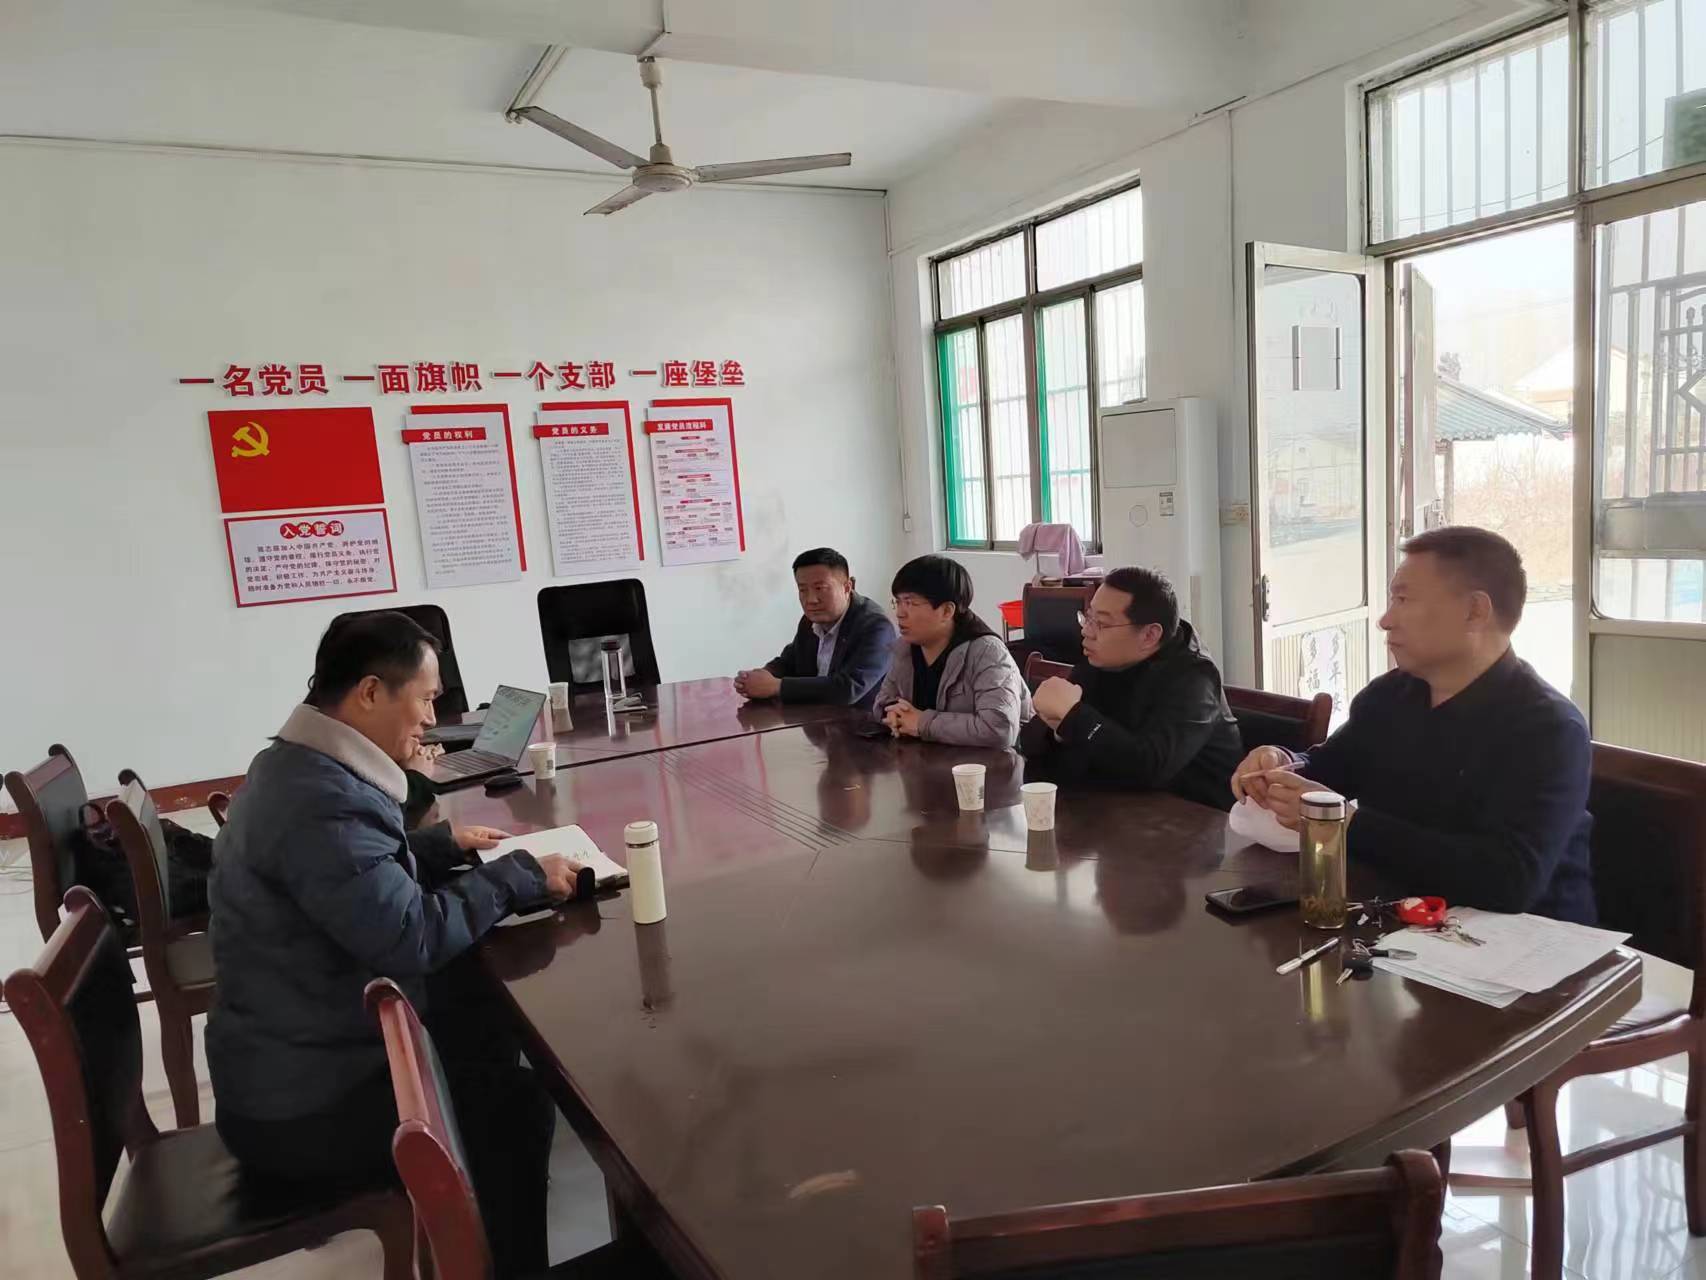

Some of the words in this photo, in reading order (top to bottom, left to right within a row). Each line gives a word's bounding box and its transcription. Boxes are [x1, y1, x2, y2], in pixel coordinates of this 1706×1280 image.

[179, 364, 329, 397] 一名党员
[343, 361, 483, 393] 一面旗帜
[494, 361, 616, 390] 一个支部
[632, 360, 745, 387] 一座堡垒
[422, 430, 473, 441] 党员的权利
[551, 425, 598, 436] 党员的义务
[283, 523, 343, 537] 入党誓词
